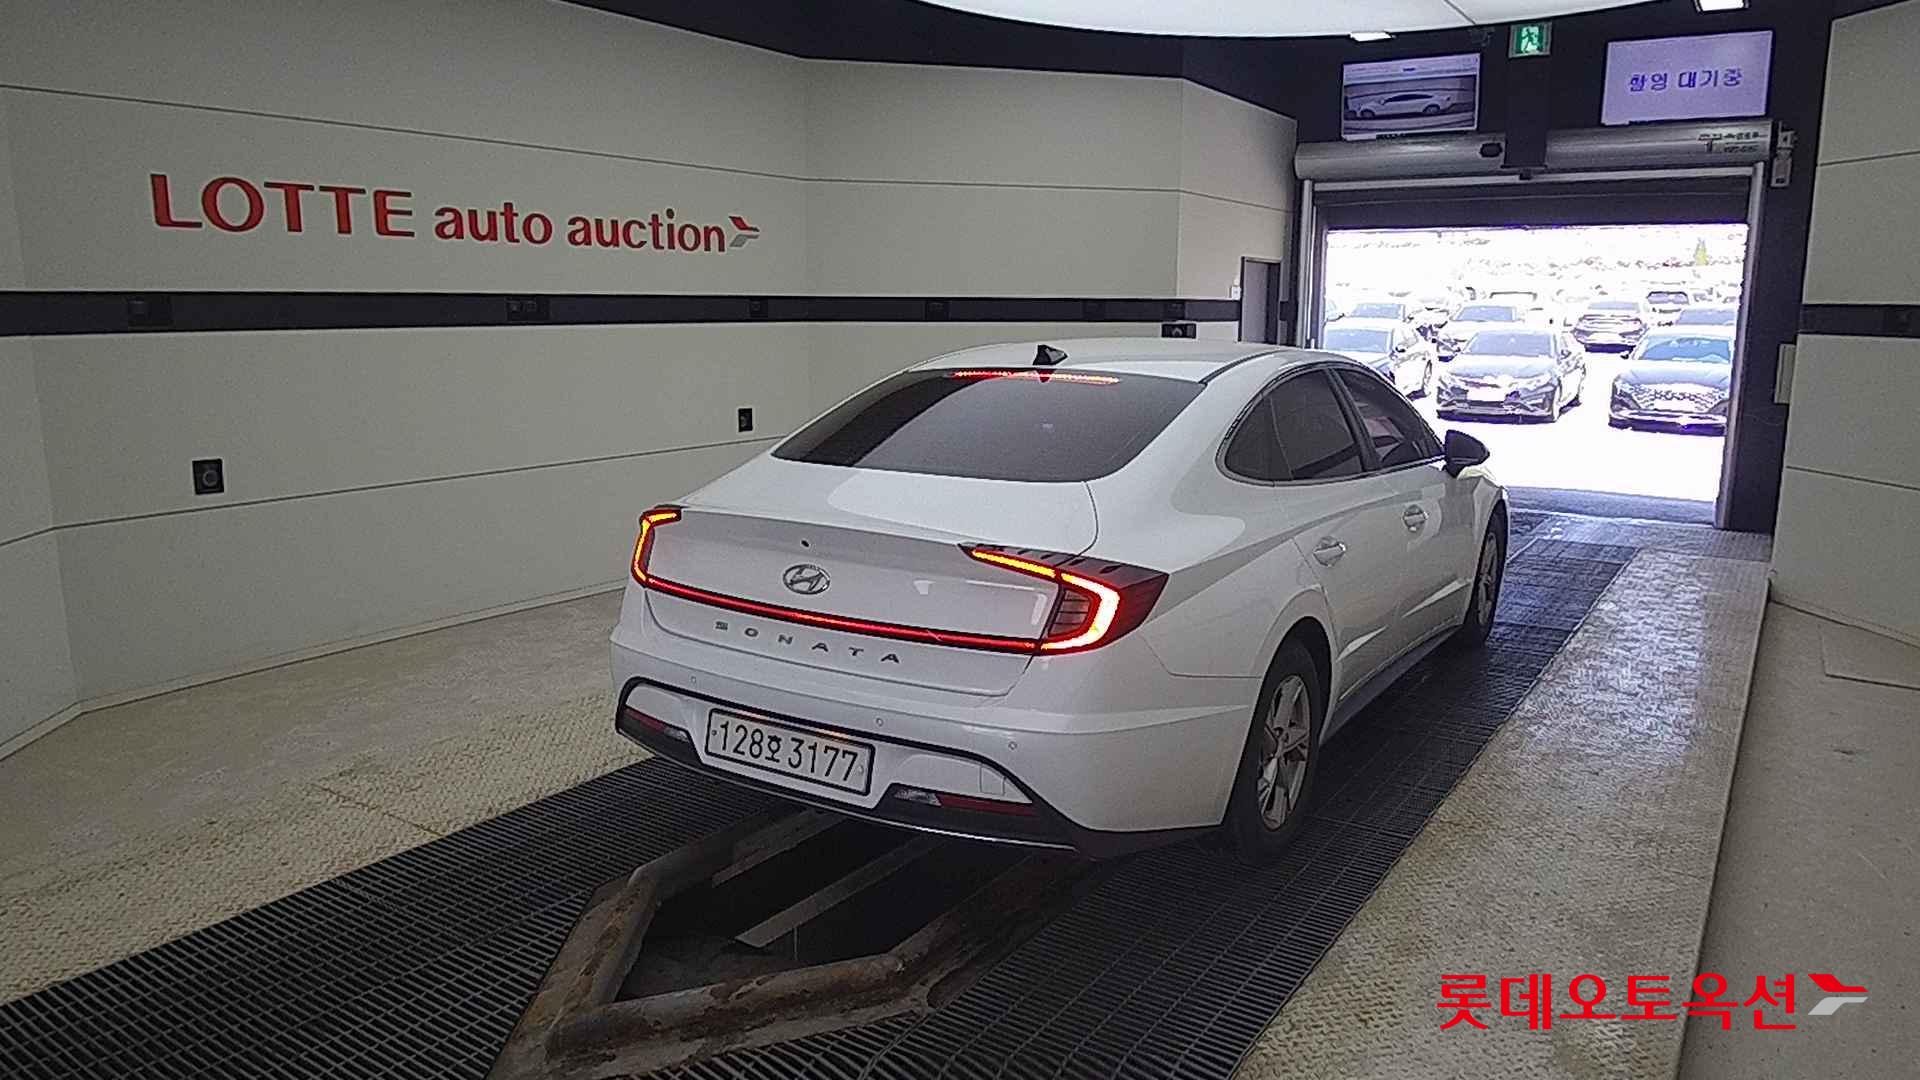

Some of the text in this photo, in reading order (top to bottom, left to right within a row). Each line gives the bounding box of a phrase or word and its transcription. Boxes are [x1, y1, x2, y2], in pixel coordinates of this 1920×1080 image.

[150, 174, 726, 252] LOTTE auto auction
[715, 621, 900, 664] SONATA
